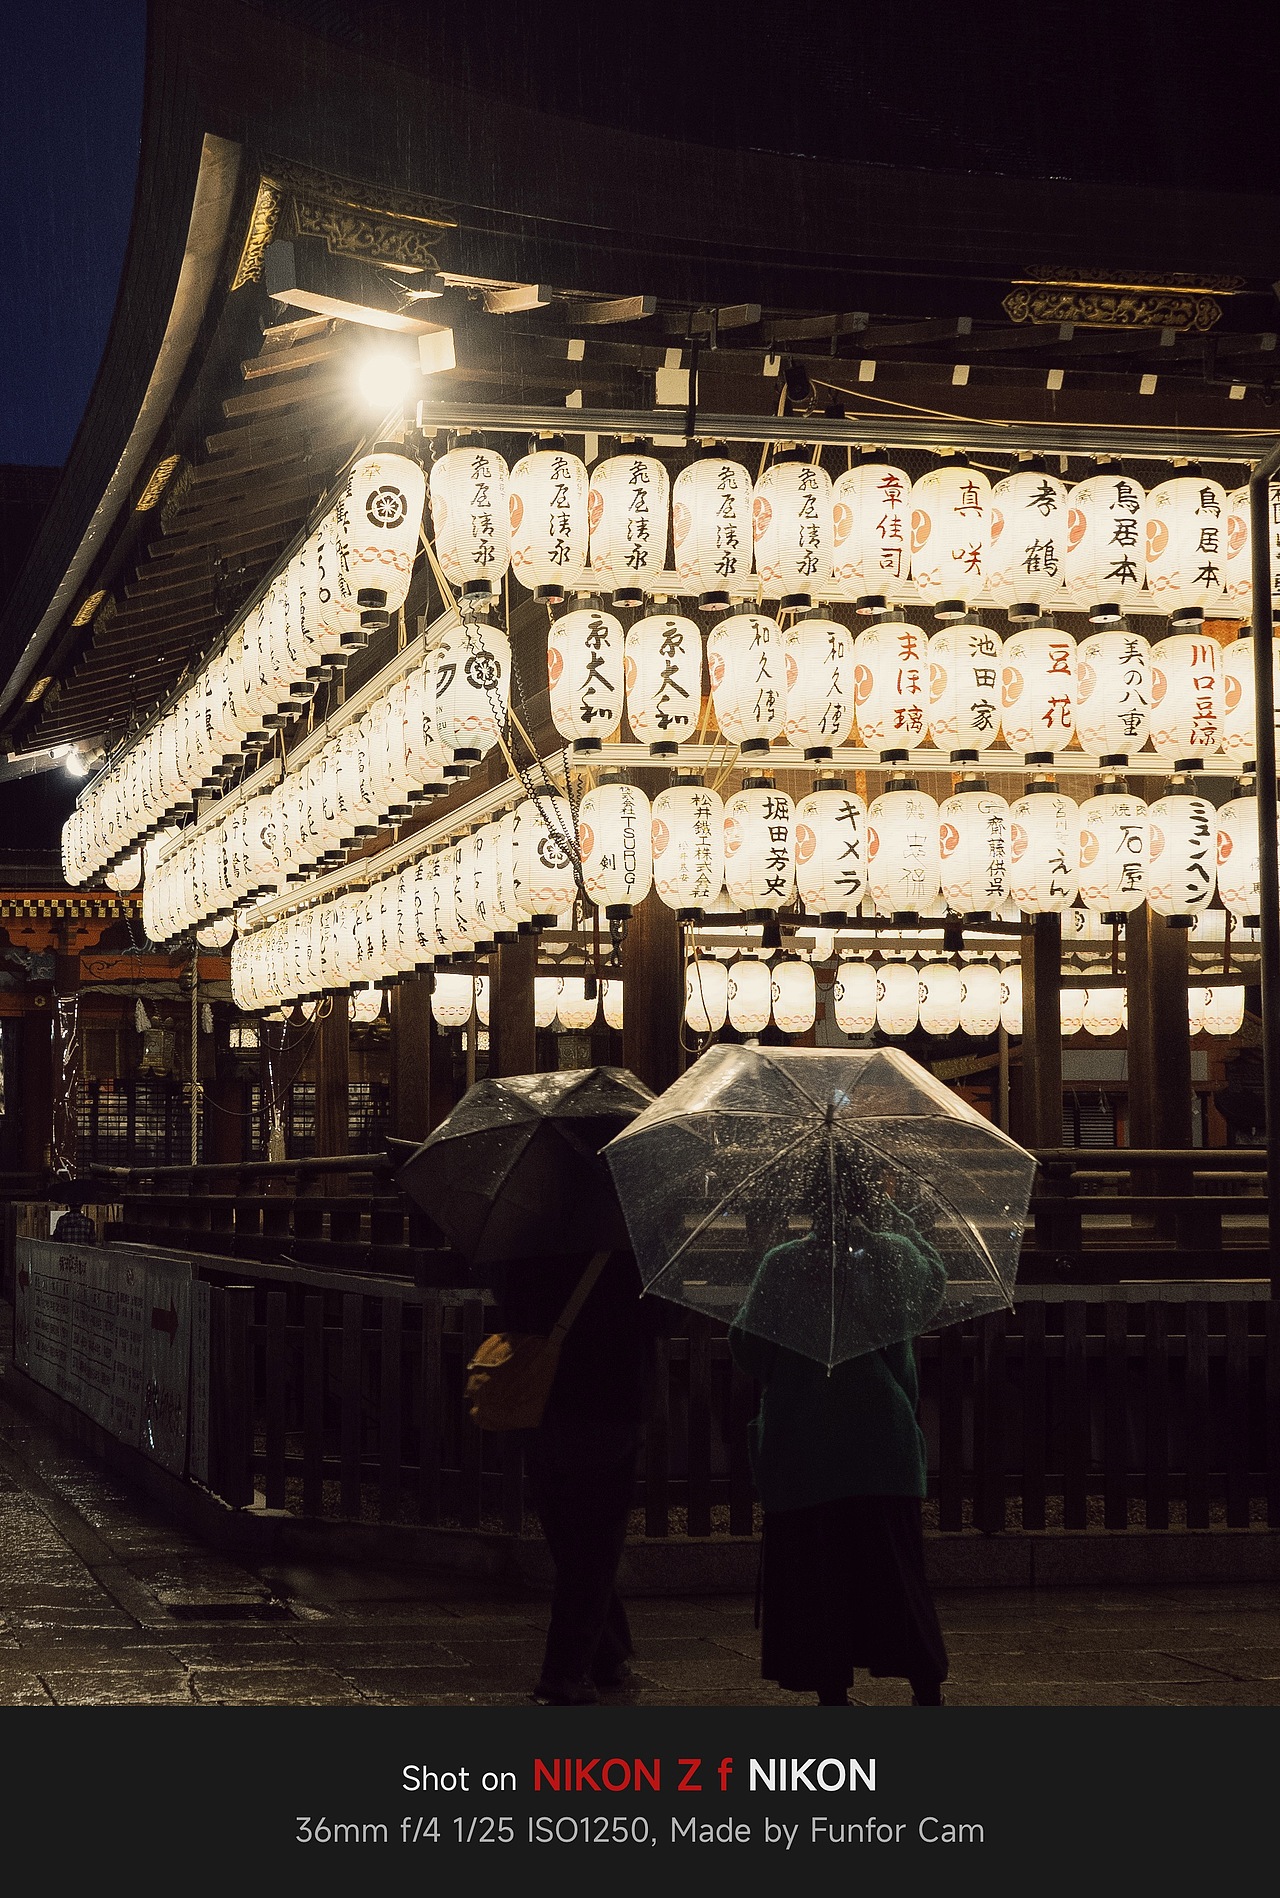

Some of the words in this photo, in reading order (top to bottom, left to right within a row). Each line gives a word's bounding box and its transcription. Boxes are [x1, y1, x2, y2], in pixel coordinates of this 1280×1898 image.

[1103, 480, 1142, 585] 鳥居本
[1191, 485, 1224, 588] 鳥居本
[968, 634, 997, 731] 池田家
[1041, 644, 1071, 728] 豆花
[1117, 637, 1148, 736] 美の八重
[599, 854, 616, 870] 剣
[834, 800, 861, 896] キメラ
[1116, 826, 1144, 892] 石屋
[1185, 801, 1211, 904] ミュンヘン
